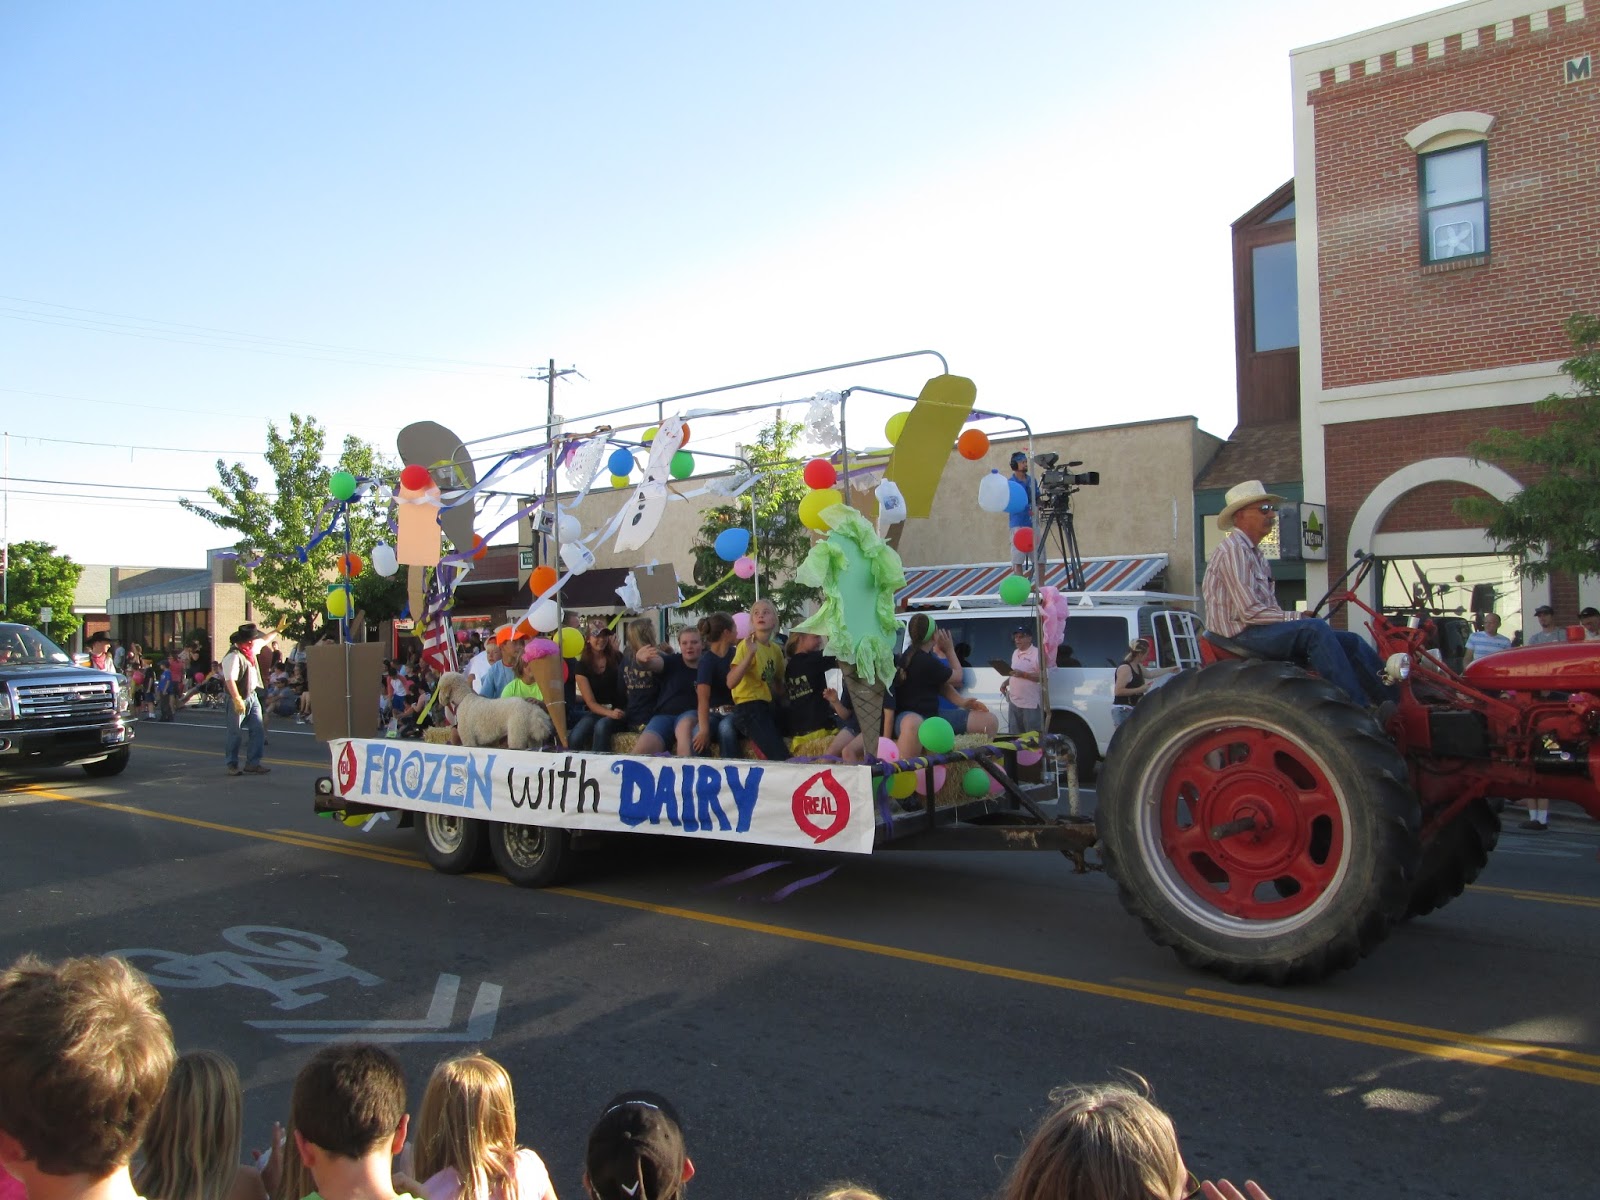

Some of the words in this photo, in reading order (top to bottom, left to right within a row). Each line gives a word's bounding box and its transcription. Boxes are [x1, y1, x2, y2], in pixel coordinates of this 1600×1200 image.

[1566, 56, 1590, 82] M
[361, 743, 497, 812] FROZEN
[507, 756, 601, 813] with
[611, 759, 764, 833] DAIRY
[802, 796, 837, 816] REAL
